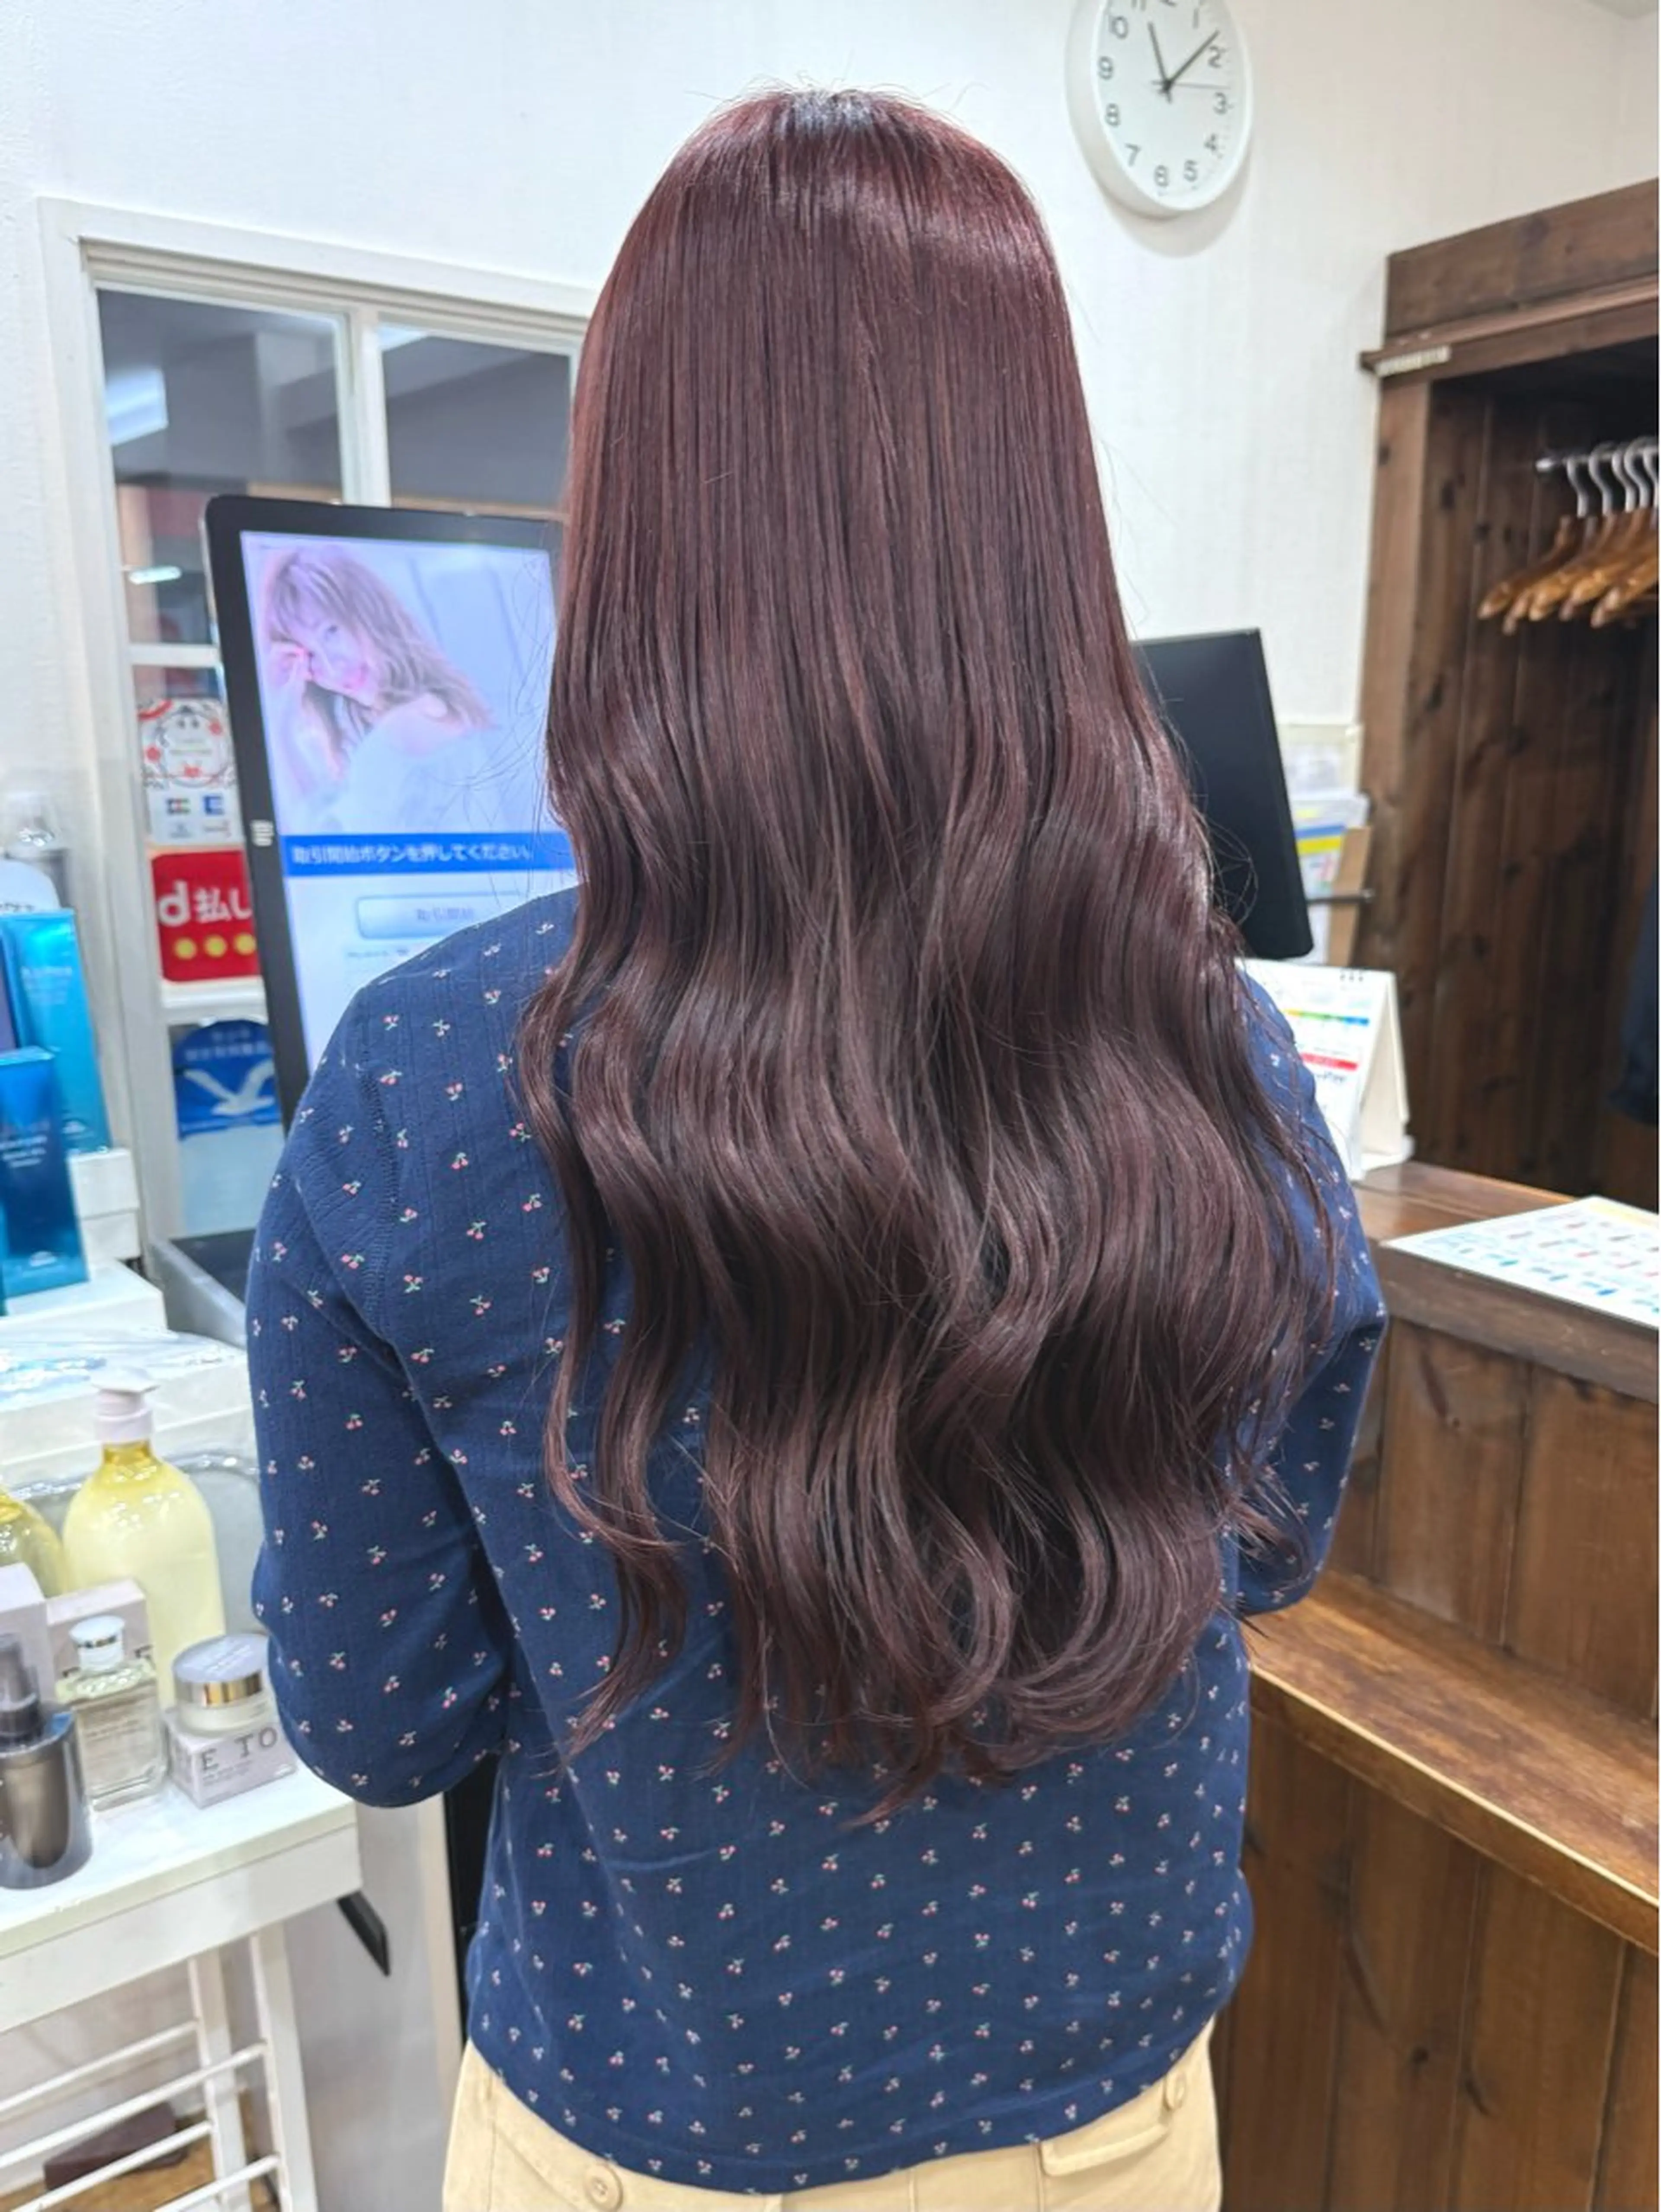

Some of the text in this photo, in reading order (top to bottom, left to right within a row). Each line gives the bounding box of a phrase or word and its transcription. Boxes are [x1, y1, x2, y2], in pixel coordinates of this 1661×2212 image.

[1098, 55, 1114, 80] 9
[1207, 45, 1223, 69] 2
[1105, 103, 1121, 128] 8
[1212, 92, 1228, 115] 3
[1124, 143, 1142, 167] 7
[1203, 133, 1218, 154] 4
[1153, 164, 1170, 188] 6
[1183, 159, 1199, 183] 5
